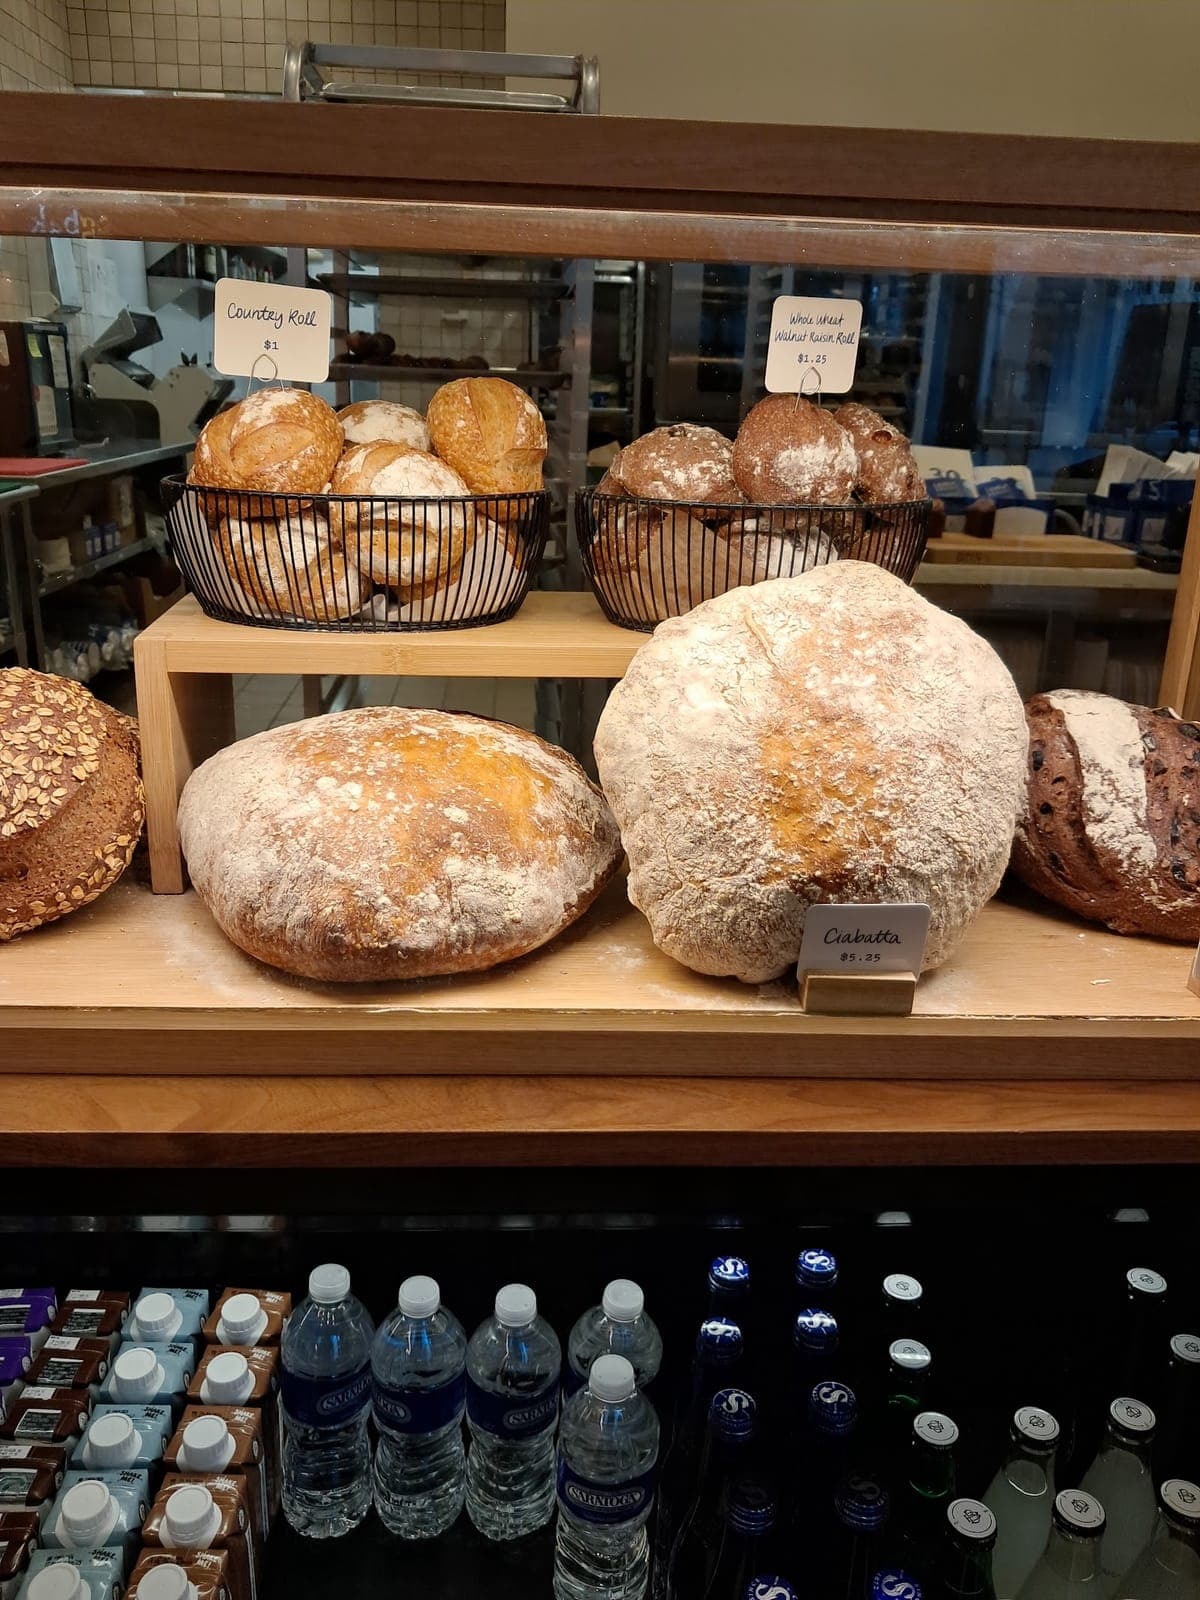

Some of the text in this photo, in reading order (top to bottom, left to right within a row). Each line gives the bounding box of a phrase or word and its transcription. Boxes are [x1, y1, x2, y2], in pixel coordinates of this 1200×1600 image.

[227, 302, 318, 330] Country Roll
[789, 313, 844, 328] Whole Wheat
[263, 339, 280, 351] $1
[774, 330, 856, 346] Walnut Raisin Roll
[797, 353, 828, 365] $1.25
[823, 927, 901, 945] Ciabatta
[839, 952, 881, 963] $5.25
[568, 1485, 641, 1507] SARATOGA
